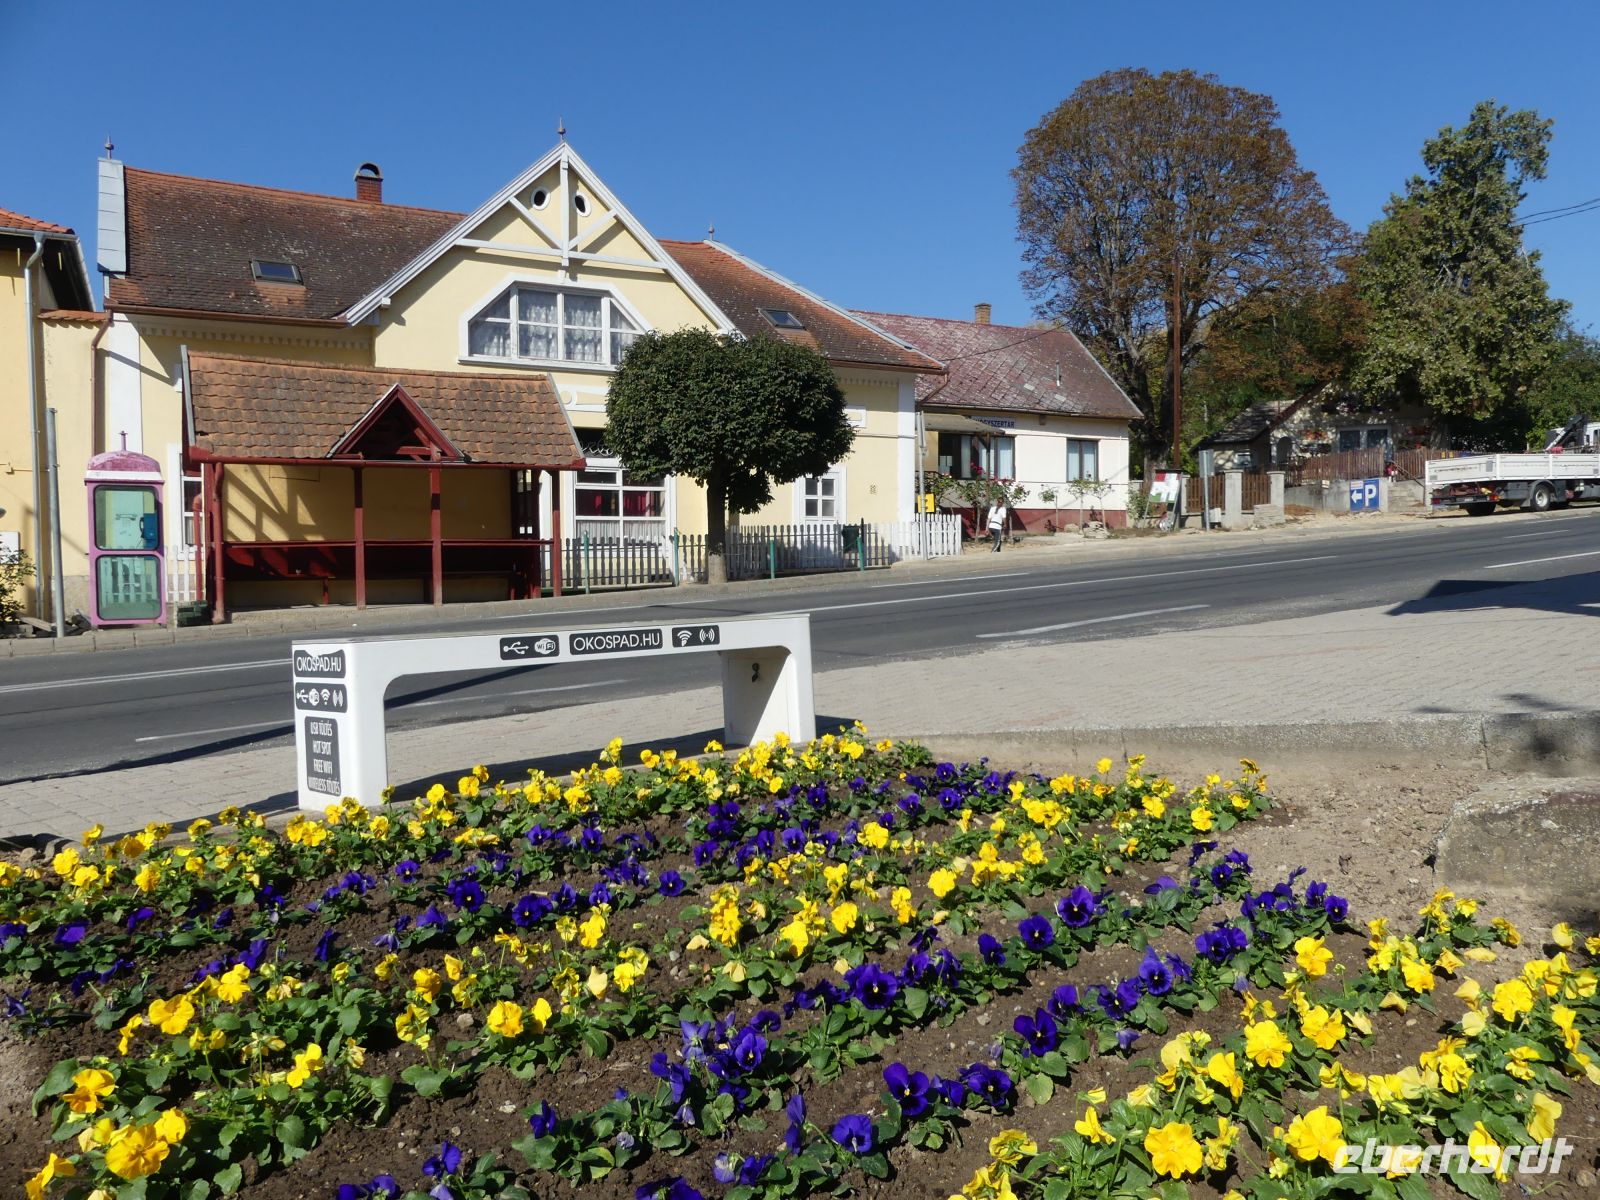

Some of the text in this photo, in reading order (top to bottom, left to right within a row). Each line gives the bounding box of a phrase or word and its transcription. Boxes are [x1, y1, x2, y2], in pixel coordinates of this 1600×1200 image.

[1364, 484, 1377, 507] P
[573, 632, 660, 651] OKOSPAD.HU
[296, 656, 342, 672] OKOSPAD.HU
[313, 758, 323, 773] FREE
